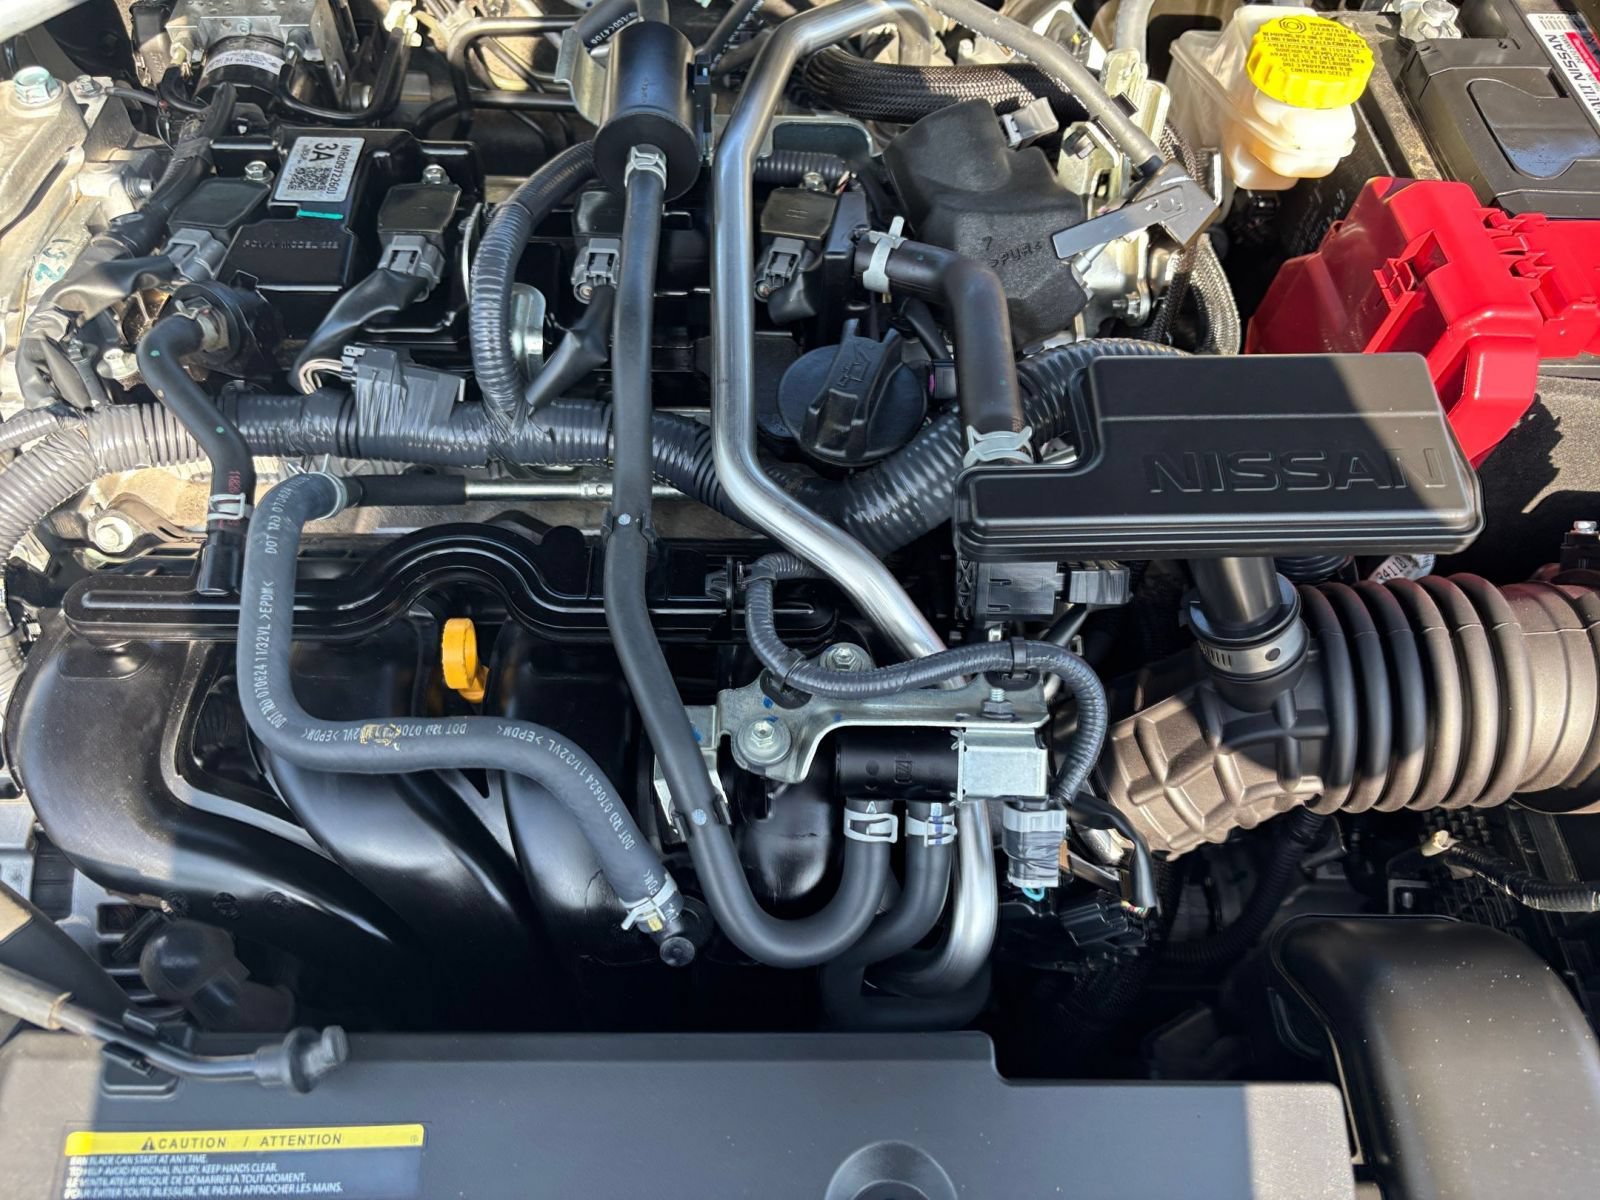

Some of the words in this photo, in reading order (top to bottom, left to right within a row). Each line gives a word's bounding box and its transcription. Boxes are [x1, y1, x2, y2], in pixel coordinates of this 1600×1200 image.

[1545, 33, 1587, 81] NISSAN
[308, 142, 339, 162] 3A
[1145, 448, 1448, 493] NISSAN
[264, 533, 279, 555] DOT
[445, 723, 468, 735] DOT
[584, 773, 614, 813] 070624
[158, 1137, 227, 1150] CAUTION
[259, 1133, 343, 1148] ATTENTION
[133, 1155, 157, 1165] START
[169, 1154, 188, 1164] ANY
[201, 1164, 222, 1174] KEEP
[222, 1163, 250, 1173] HANDS
[171, 1175, 183, 1186] DE
[241, 1173, 264, 1184] TOUT
[198, 1185, 211, 1196] NE
[211, 1185, 228, 1196] PAS
[229, 1184, 241, 1195] EN
[242, 1183, 295, 1195] APPROCHER
[295, 1182, 311, 1193] LES
